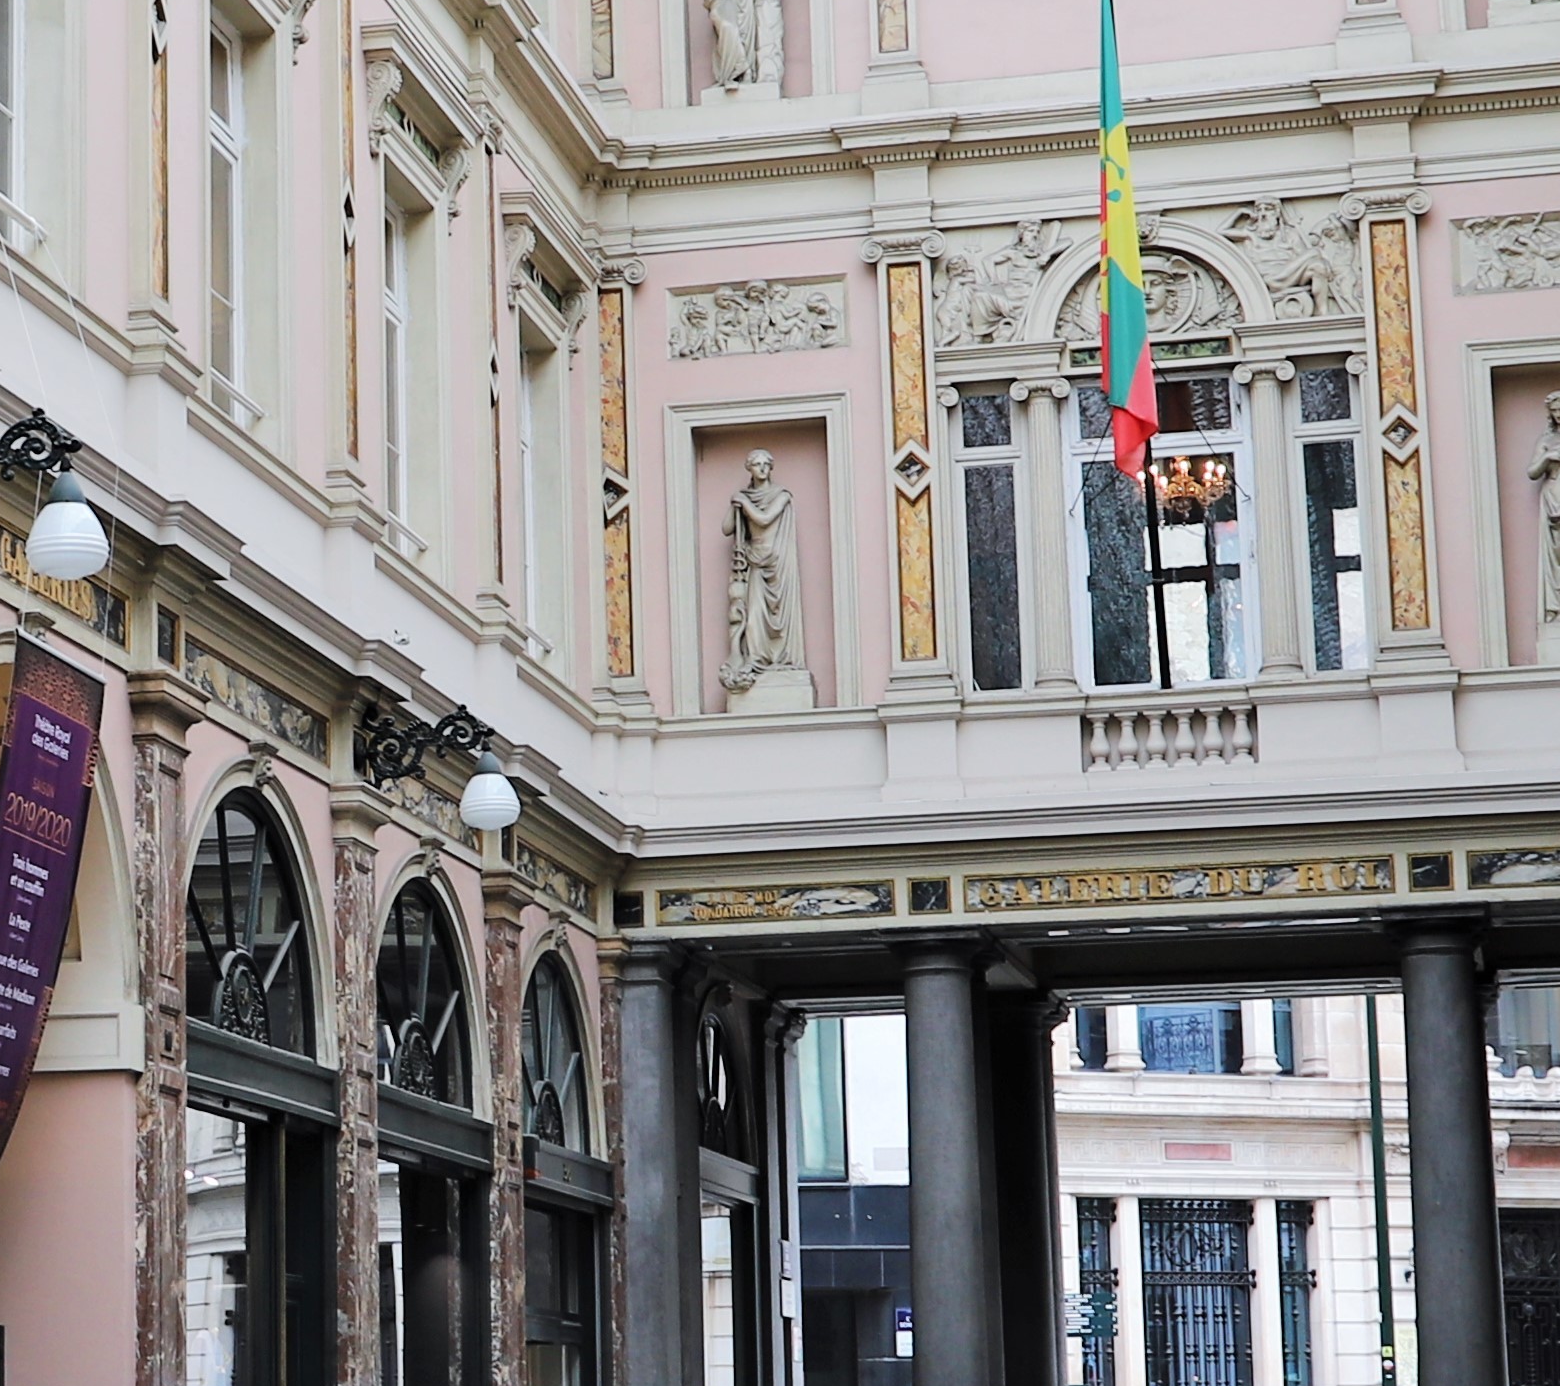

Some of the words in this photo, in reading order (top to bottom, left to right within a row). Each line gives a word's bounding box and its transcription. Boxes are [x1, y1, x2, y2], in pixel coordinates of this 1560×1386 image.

[4, 792, 72, 847] 2019/2020
[981, 870, 1174, 907] GALERIE
[1206, 867, 1268, 896] DU
[1297, 860, 1379, 891] ROI
